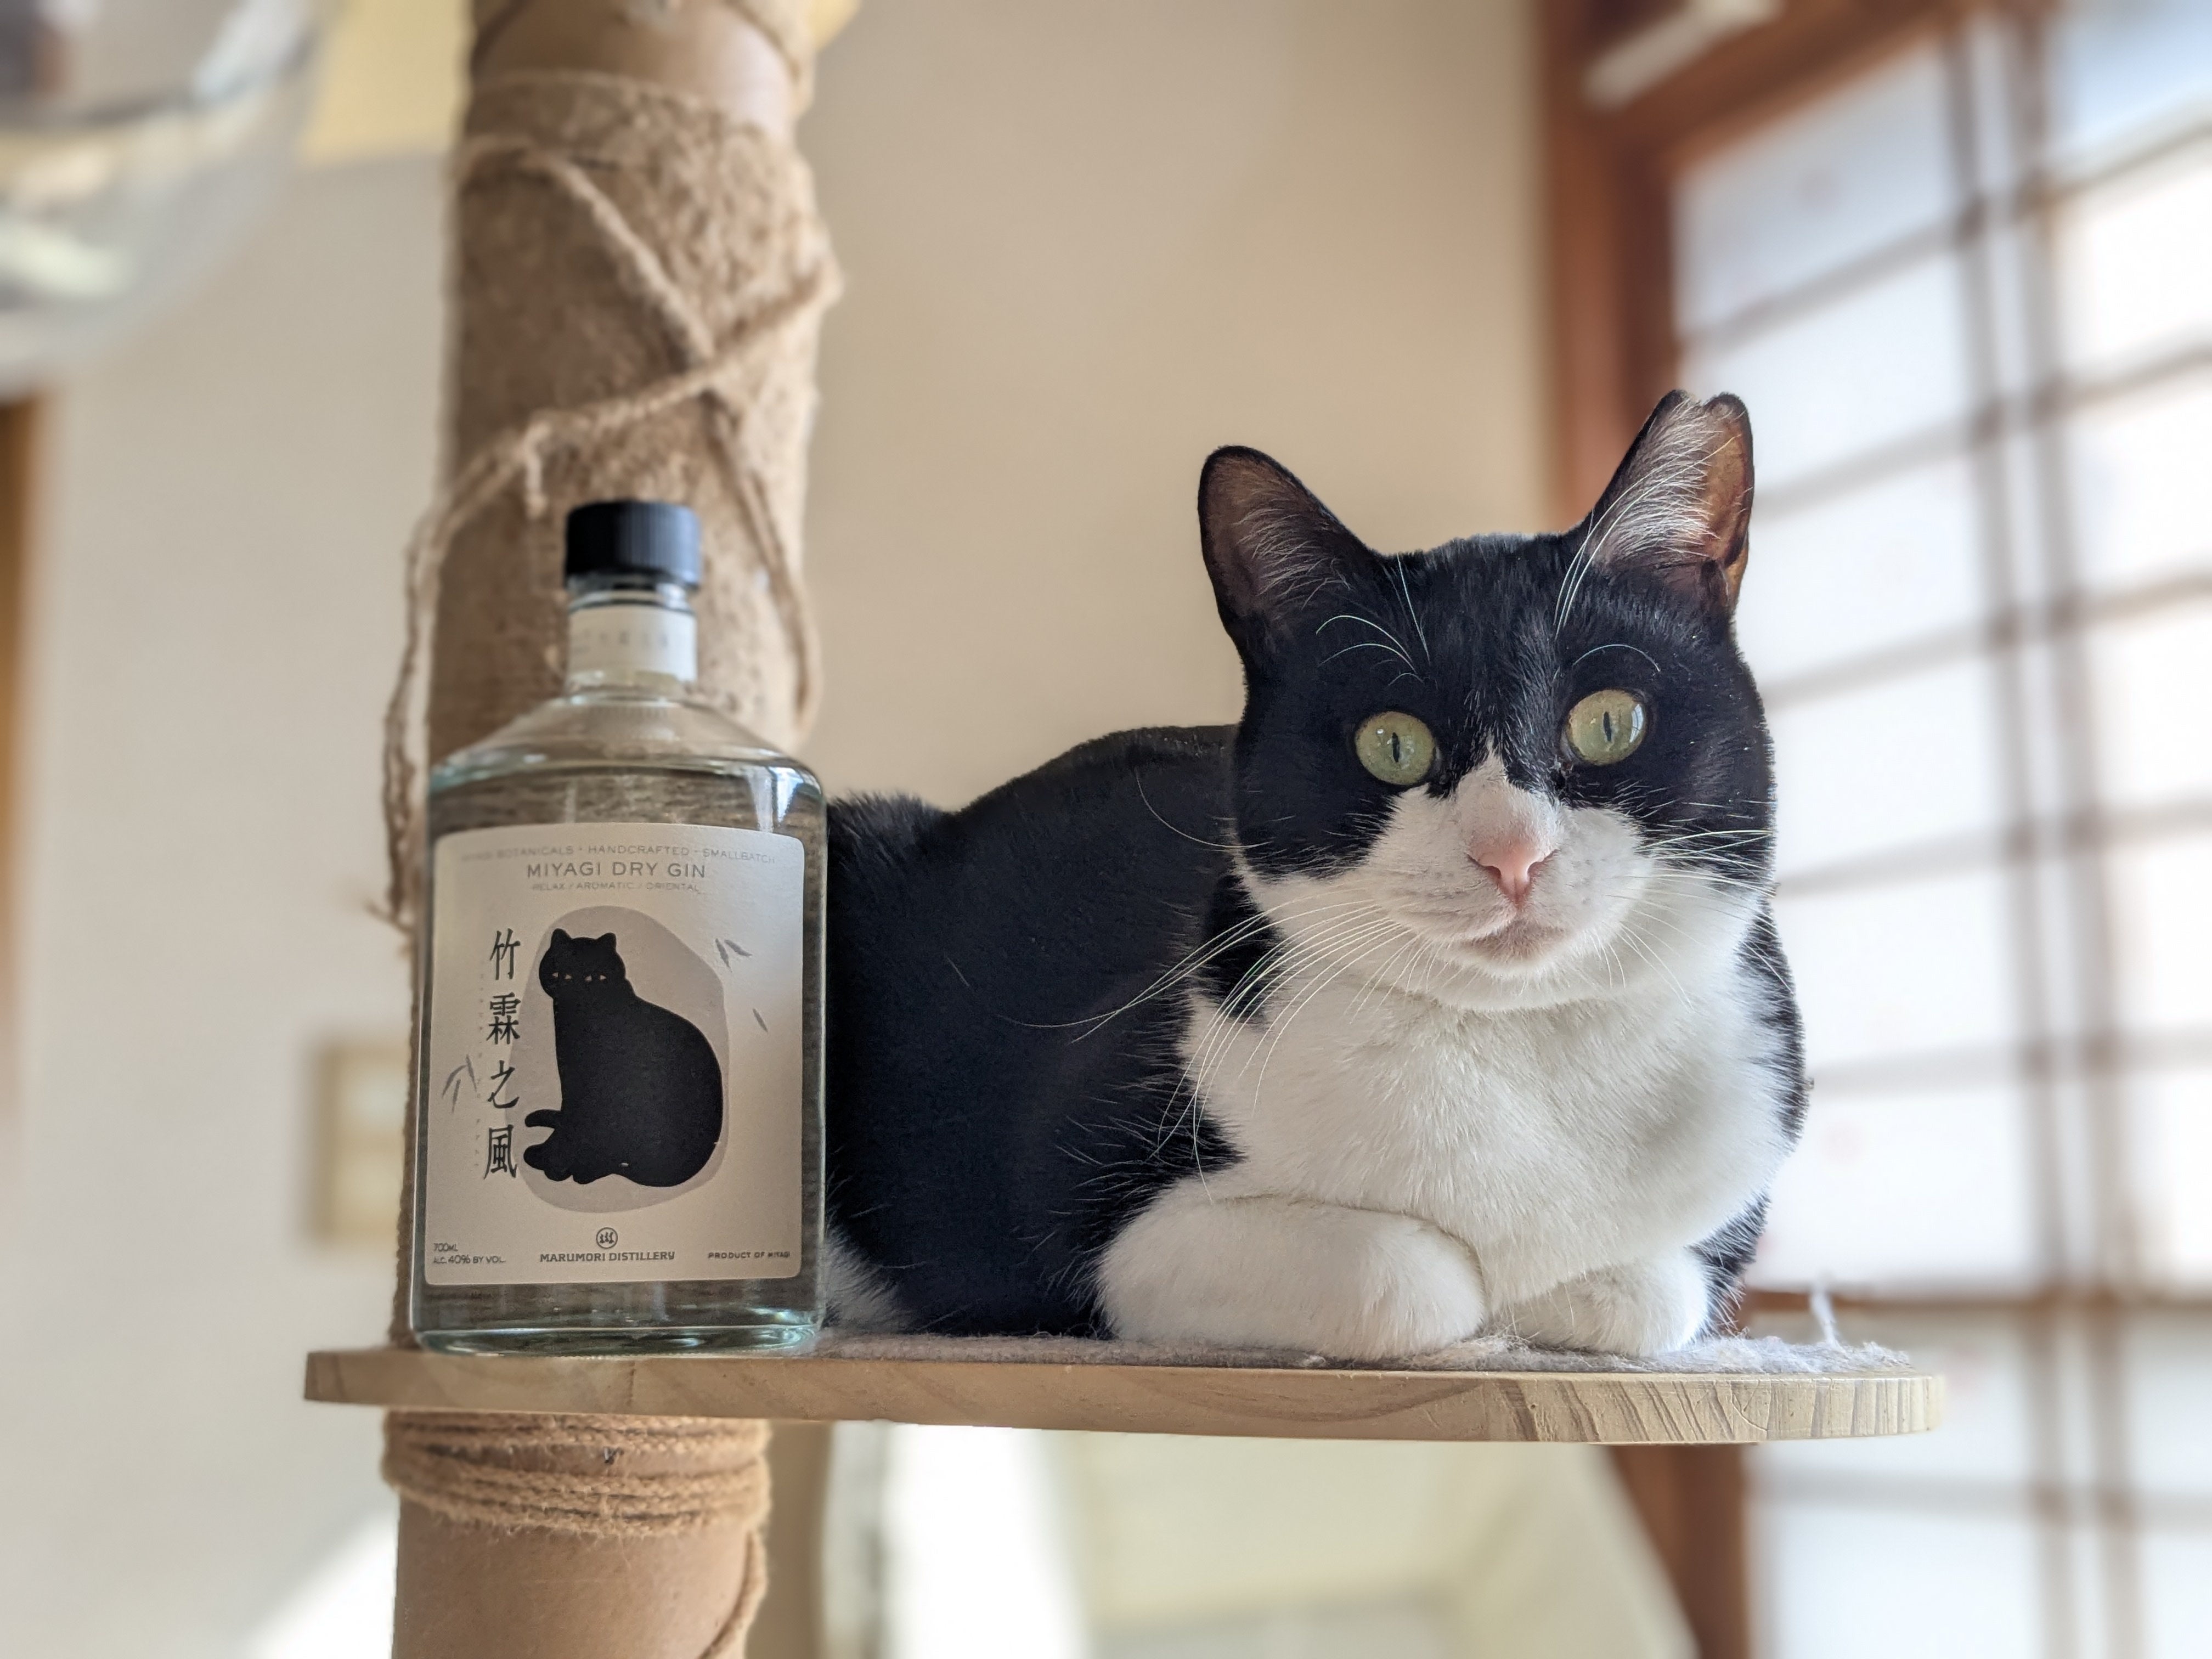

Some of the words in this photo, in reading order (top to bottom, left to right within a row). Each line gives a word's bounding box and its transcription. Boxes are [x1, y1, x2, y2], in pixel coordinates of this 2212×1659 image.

[589, 845, 689, 855] HANDCRAFTED
[703, 848, 774, 864] SMALLBATCH
[527, 861, 601, 878] MIYAGI
[612, 862, 658, 876] DRY
[668, 862, 705, 878] GIN
[532, 882, 565, 890] RELAX
[577, 881, 633, 890] AROMATIC
[647, 882, 699, 892] ORIENTAL
[448, 1255, 471, 1263] 40%
[540, 1253, 605, 1262] MARUMORI
[609, 1251, 675, 1261] DISTILLERY
